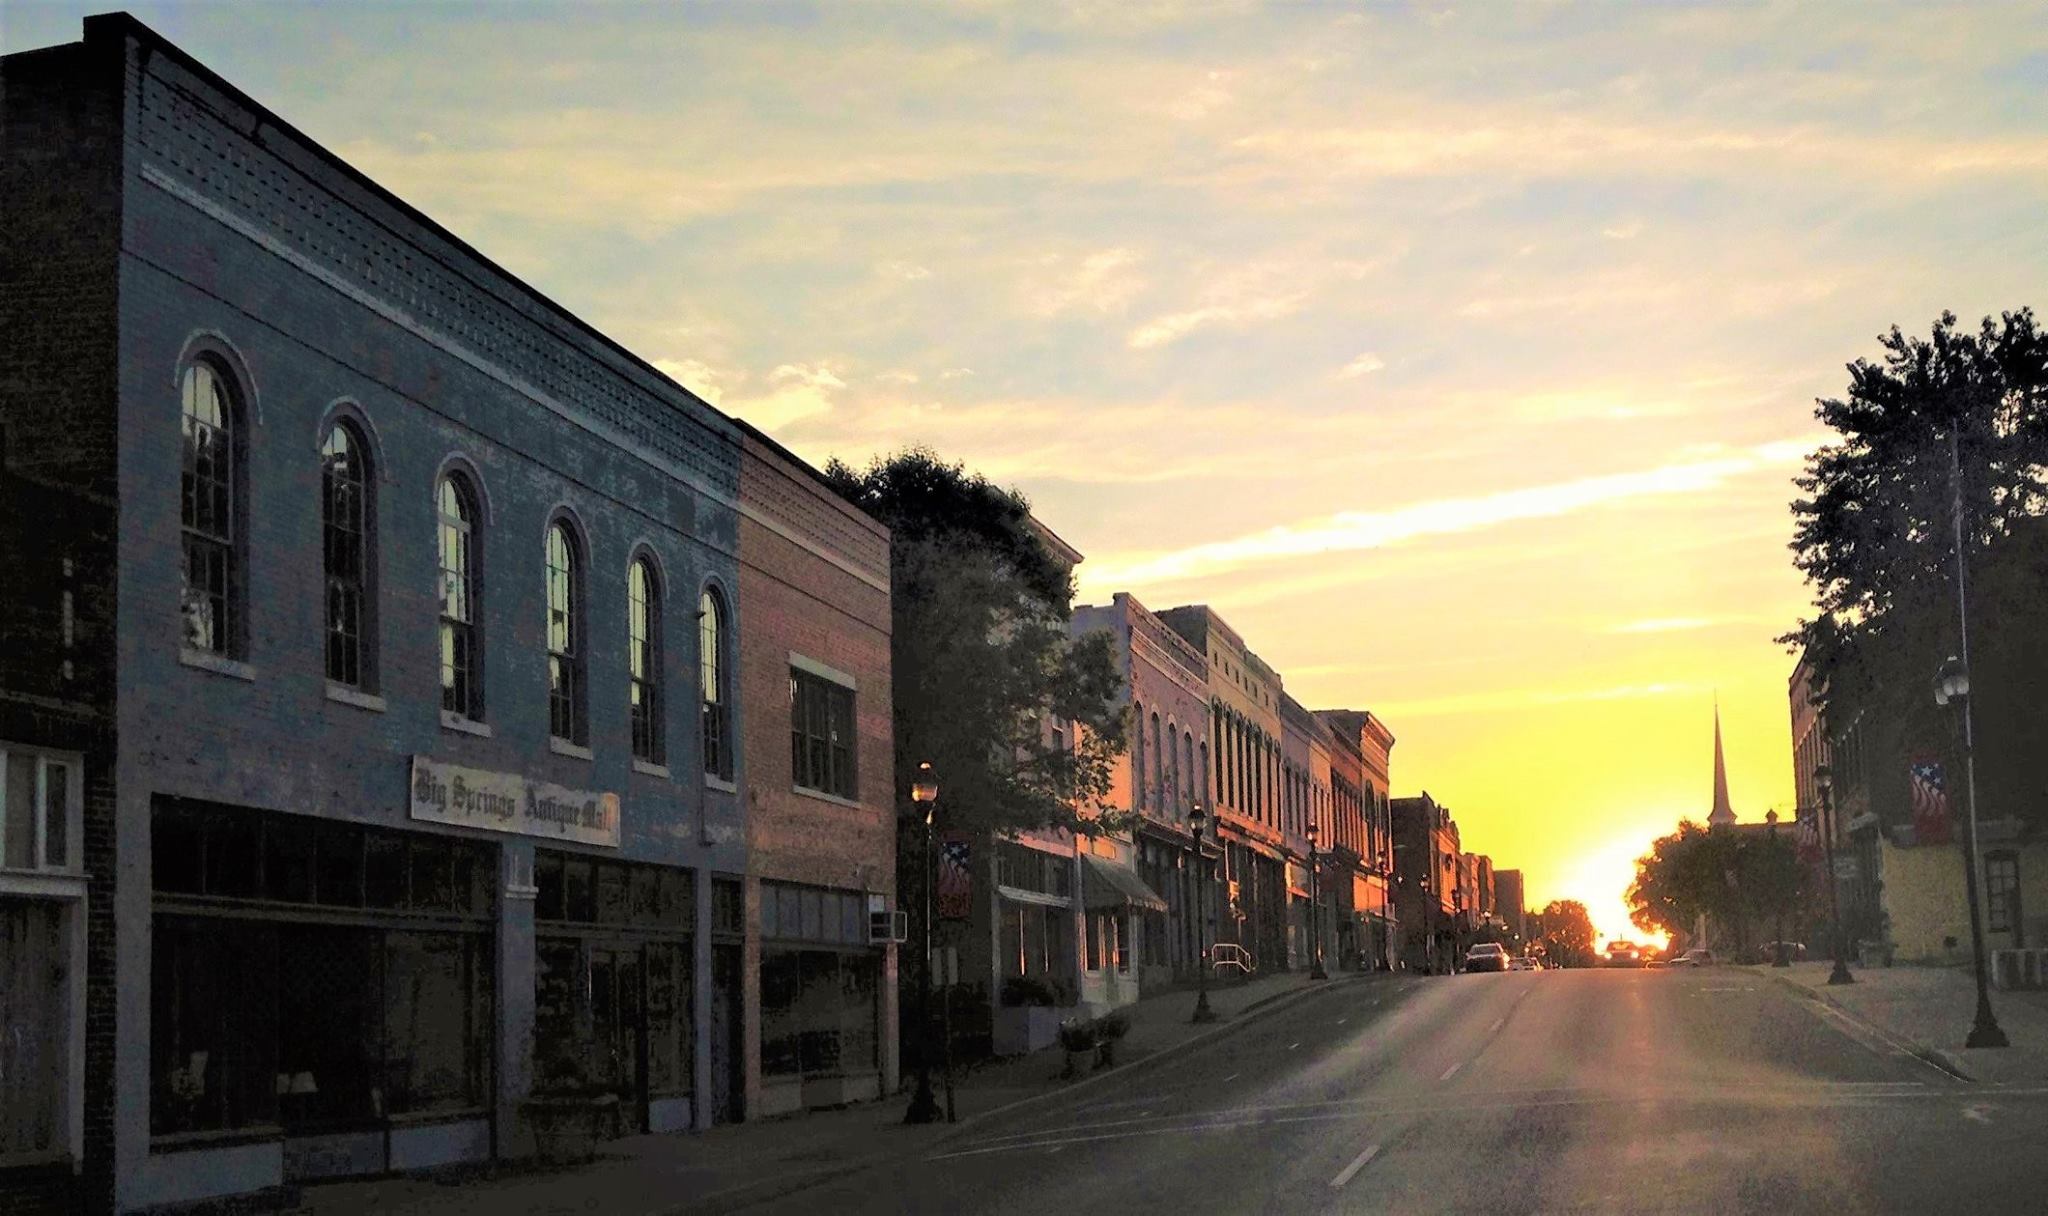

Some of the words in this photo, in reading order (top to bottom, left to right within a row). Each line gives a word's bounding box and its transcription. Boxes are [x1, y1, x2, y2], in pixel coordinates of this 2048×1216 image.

[415, 768, 447, 813] Big
[453, 775, 515, 822] Springs
[524, 783, 580, 833] Antique
